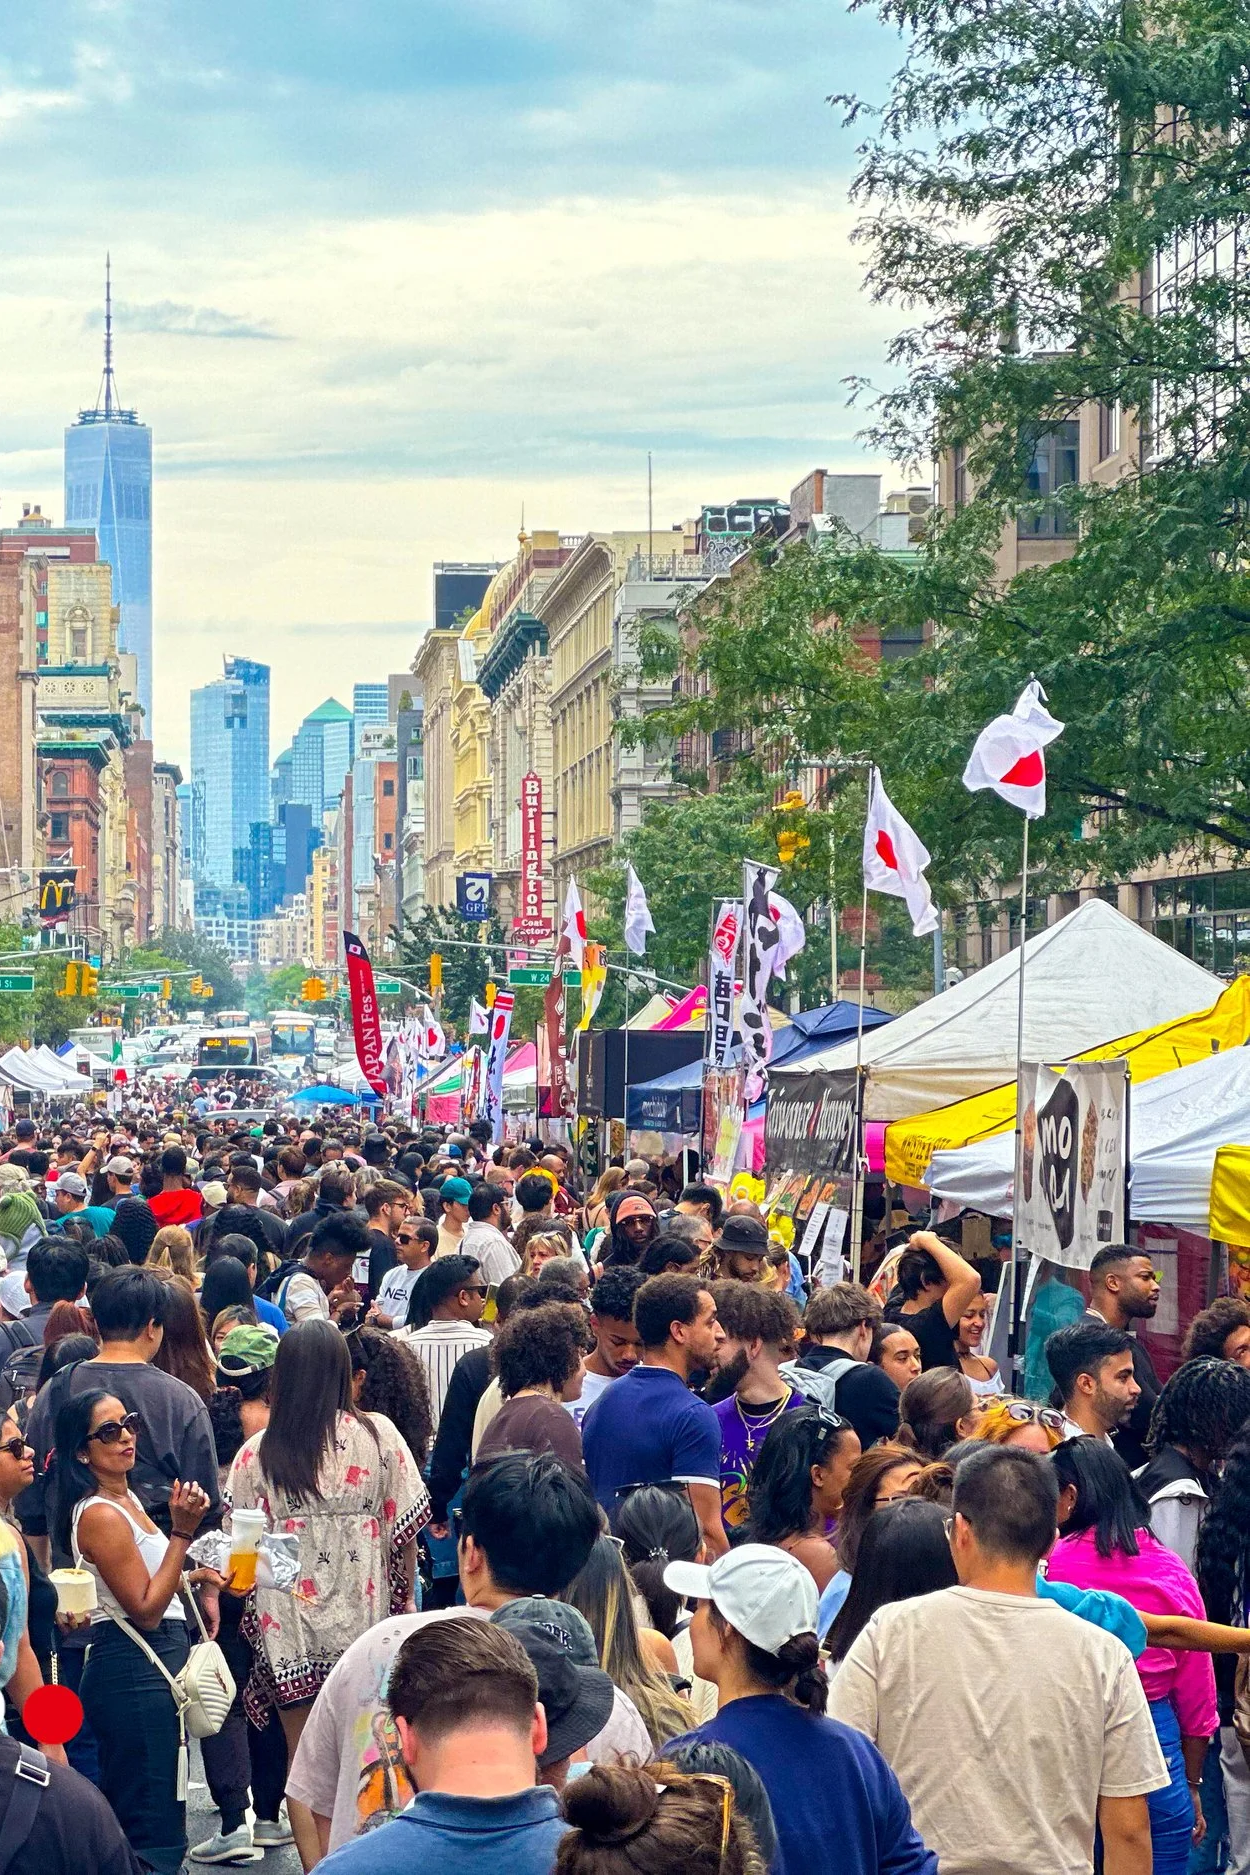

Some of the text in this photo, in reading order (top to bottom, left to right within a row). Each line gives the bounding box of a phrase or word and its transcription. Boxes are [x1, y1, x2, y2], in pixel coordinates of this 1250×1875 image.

[525, 780, 540, 916] Burlington
[465, 902, 488, 912] GFP
[521, 919, 544, 927] Coat
[530, 974, 550, 982] W 24
[4, 979, 13, 988] St
[362, 1028, 384, 1085] JAPAN
